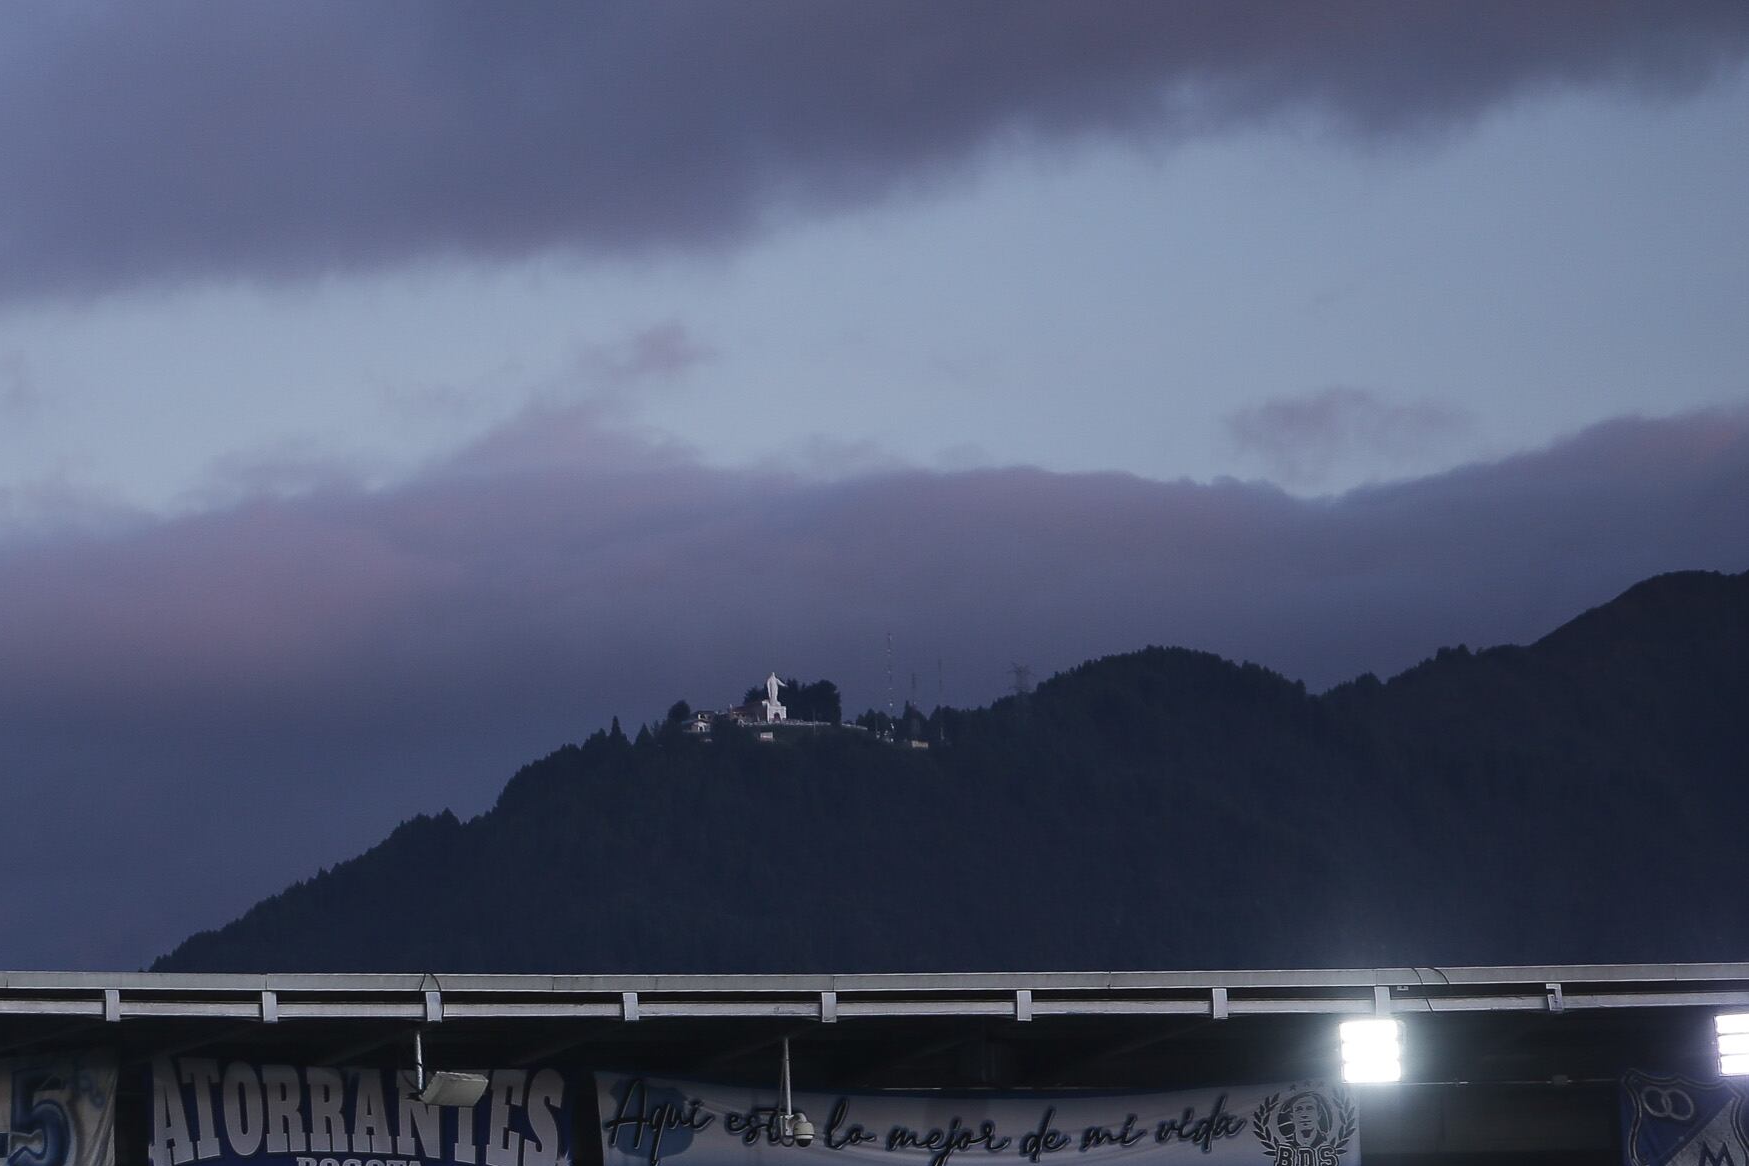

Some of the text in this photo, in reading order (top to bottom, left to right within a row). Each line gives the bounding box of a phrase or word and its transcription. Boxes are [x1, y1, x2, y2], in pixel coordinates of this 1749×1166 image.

[1020, 1105, 1070, 1163] de
[1079, 1113, 1146, 1152] mi
[1155, 1094, 1248, 1153] vida
